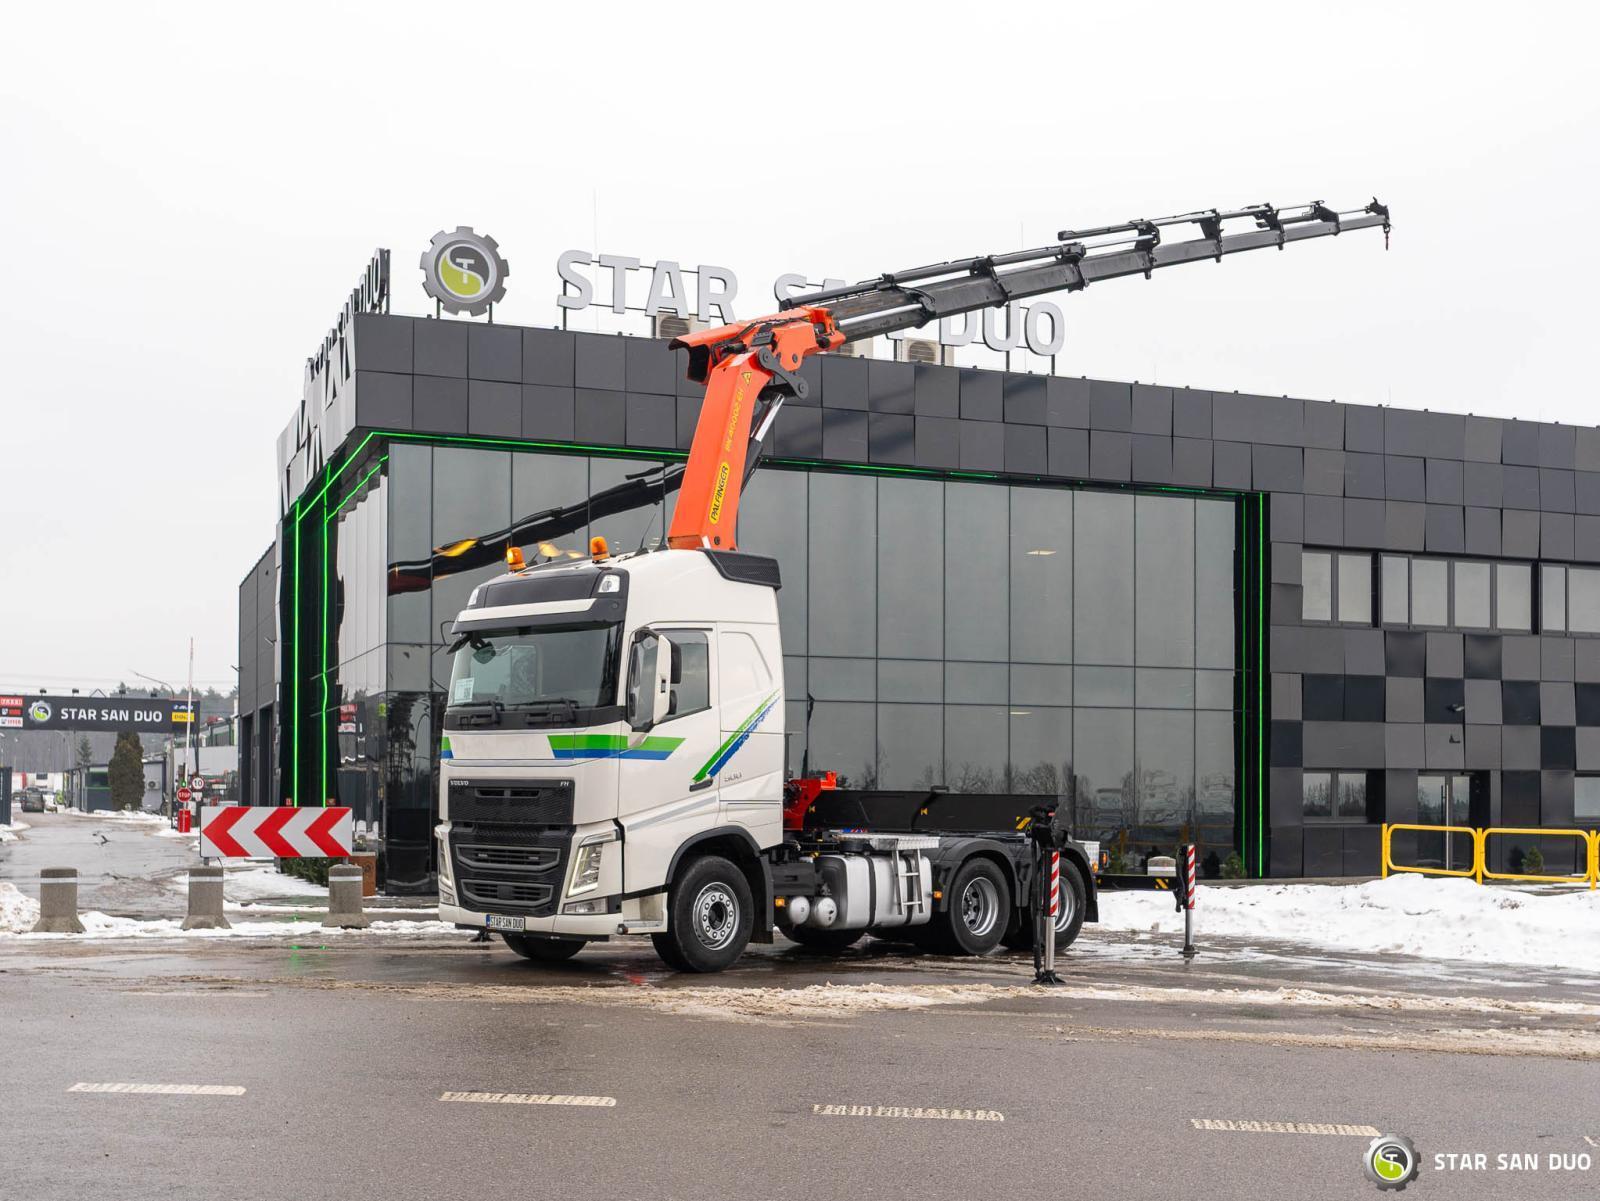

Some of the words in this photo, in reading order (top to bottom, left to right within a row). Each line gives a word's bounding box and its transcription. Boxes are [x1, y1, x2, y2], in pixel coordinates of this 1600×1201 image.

[557, 249, 738, 326] STAR
[710, 465, 729, 521] PALFINGER
[60, 707, 97, 721] STAR
[101, 709, 129, 722] SAN
[134, 710, 163, 723] DUO
